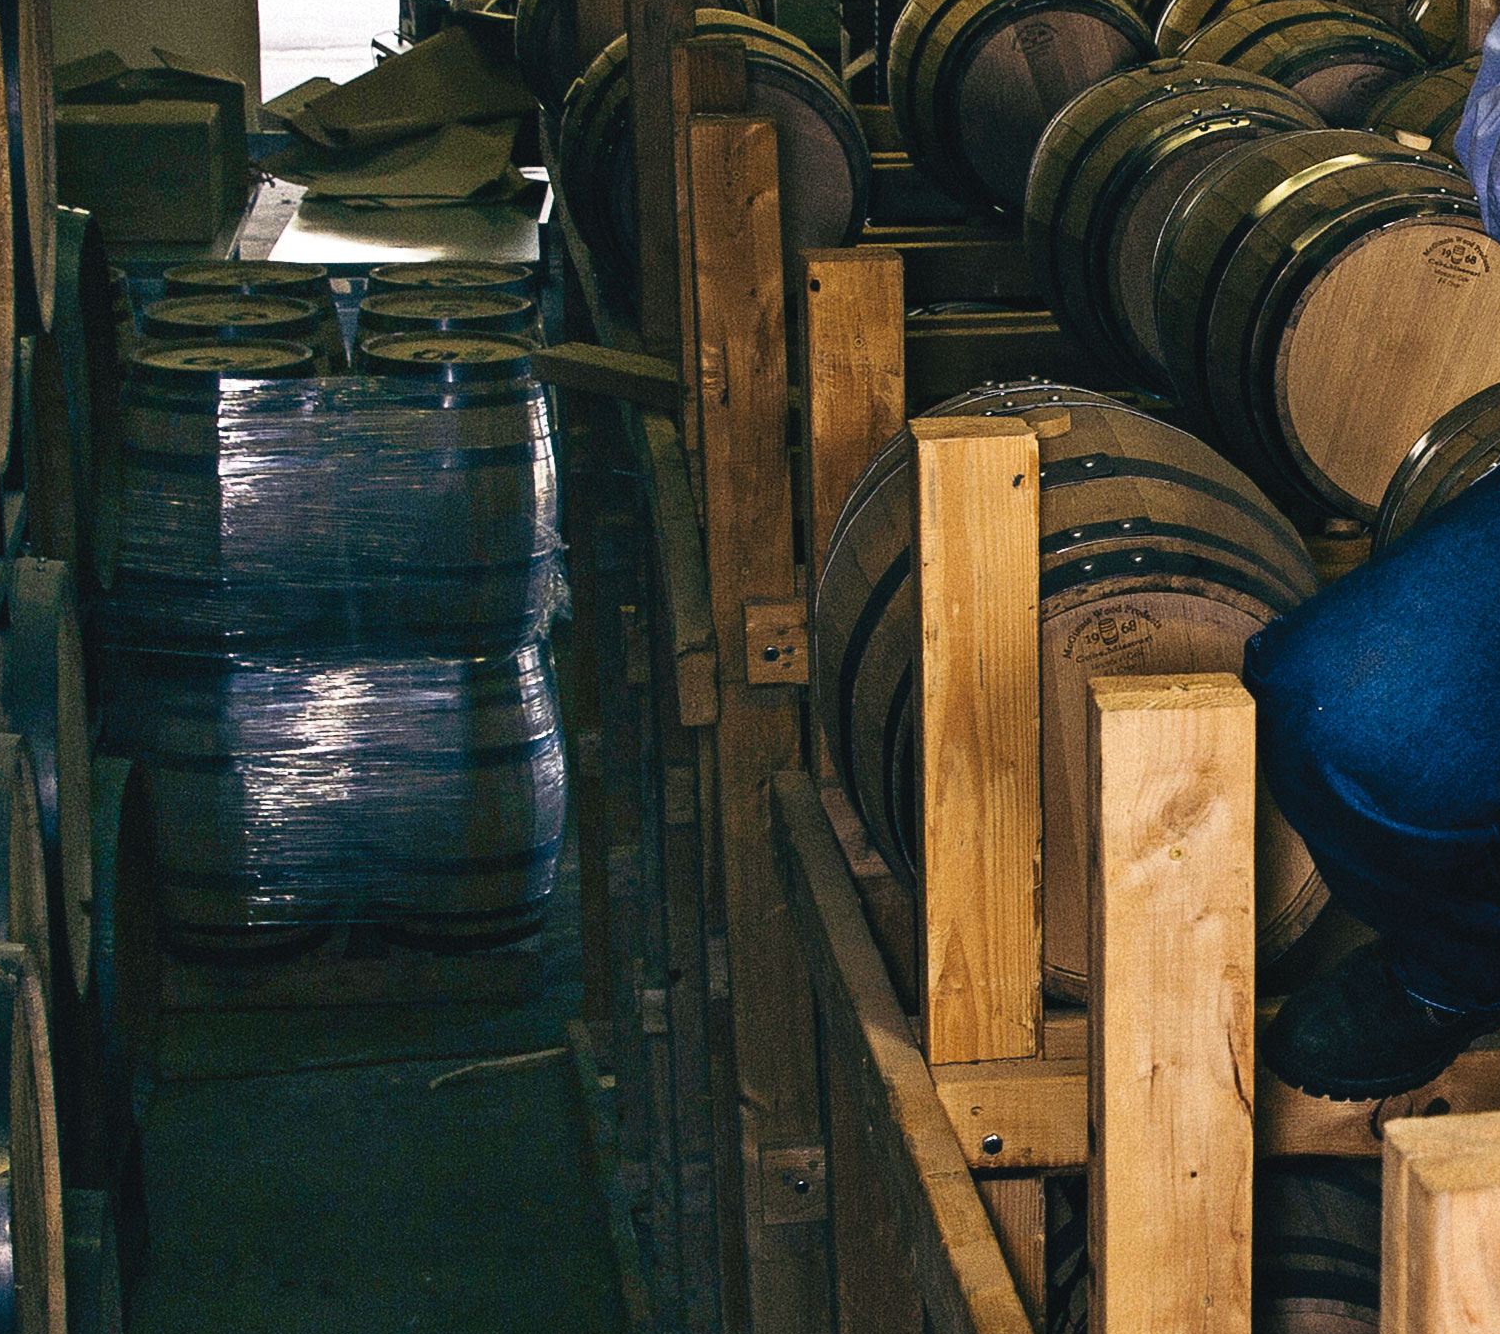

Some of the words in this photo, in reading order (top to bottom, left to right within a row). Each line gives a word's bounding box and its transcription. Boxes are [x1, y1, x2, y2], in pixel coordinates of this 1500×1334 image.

[1464, 254, 1477, 265] 68
[1092, 604, 1122, 619] Wood
[1085, 632, 1100, 645] 19
[1121, 619, 1137, 634] 68
